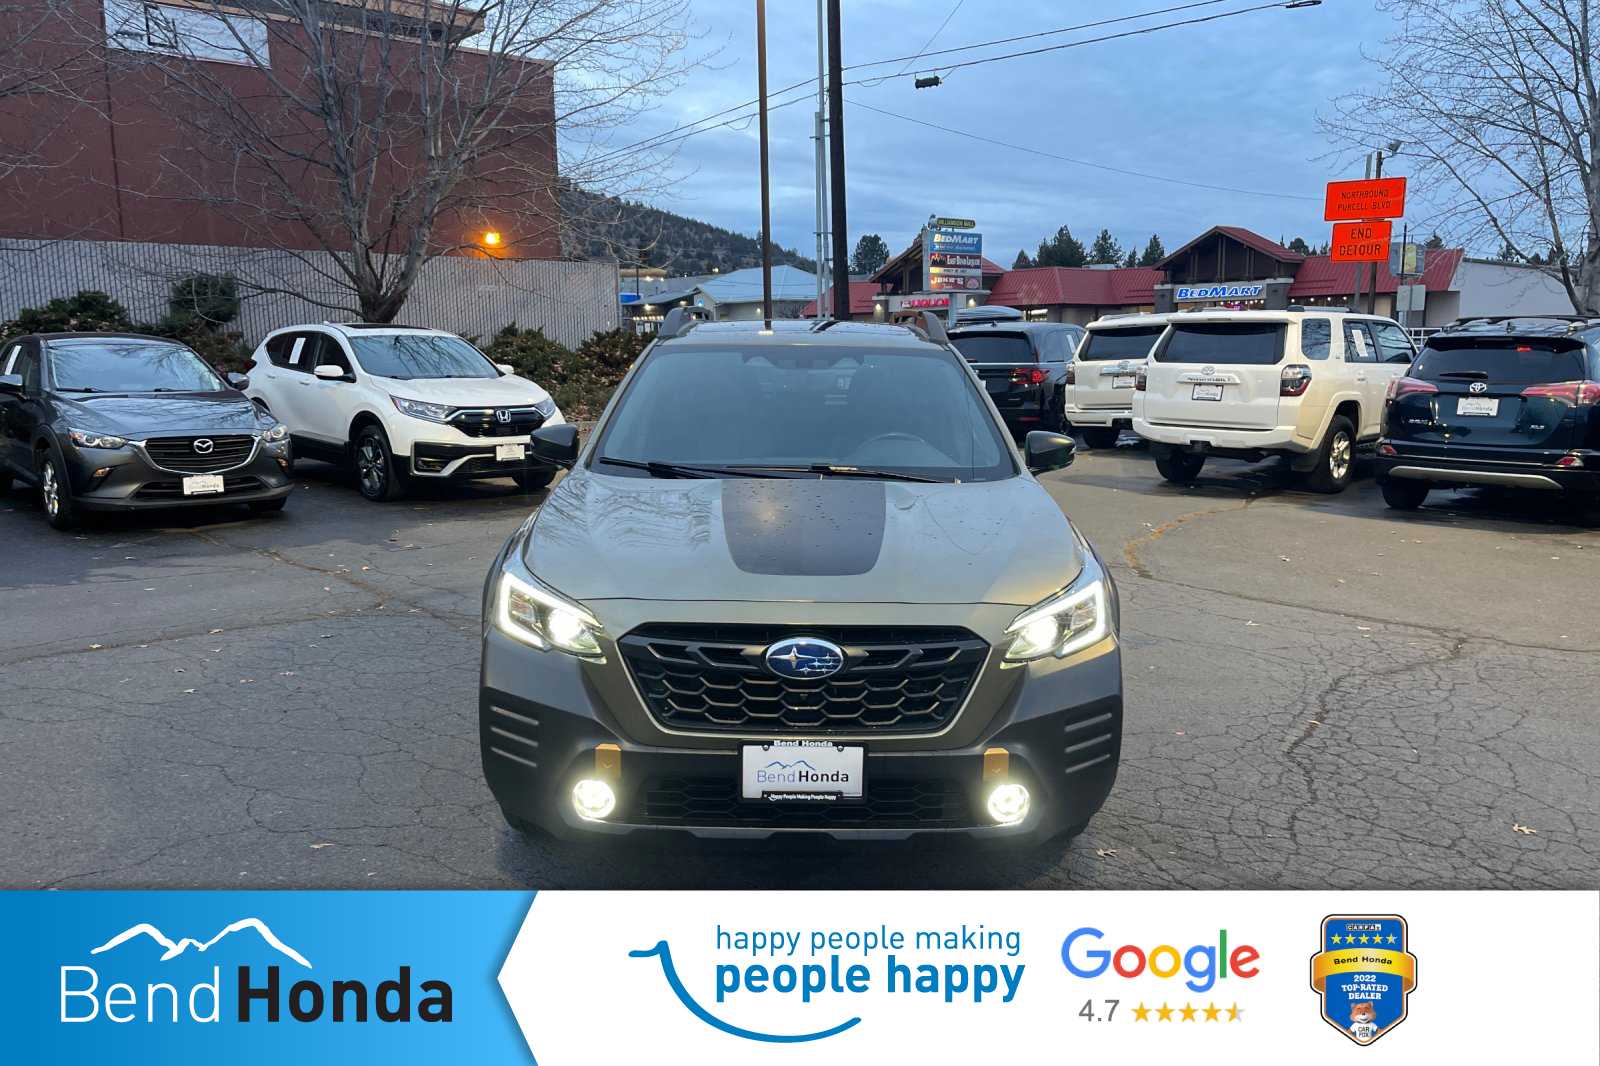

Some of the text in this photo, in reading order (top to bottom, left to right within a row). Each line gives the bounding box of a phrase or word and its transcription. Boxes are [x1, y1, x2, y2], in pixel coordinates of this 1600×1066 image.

[1341, 189, 1389, 199] NORTHBOUND
[1337, 200, 1391, 211] PURCELL BLVD
[1351, 227, 1372, 240] END
[1339, 244, 1382, 256] DETOUR
[757, 770, 849, 783] Bend Honda
